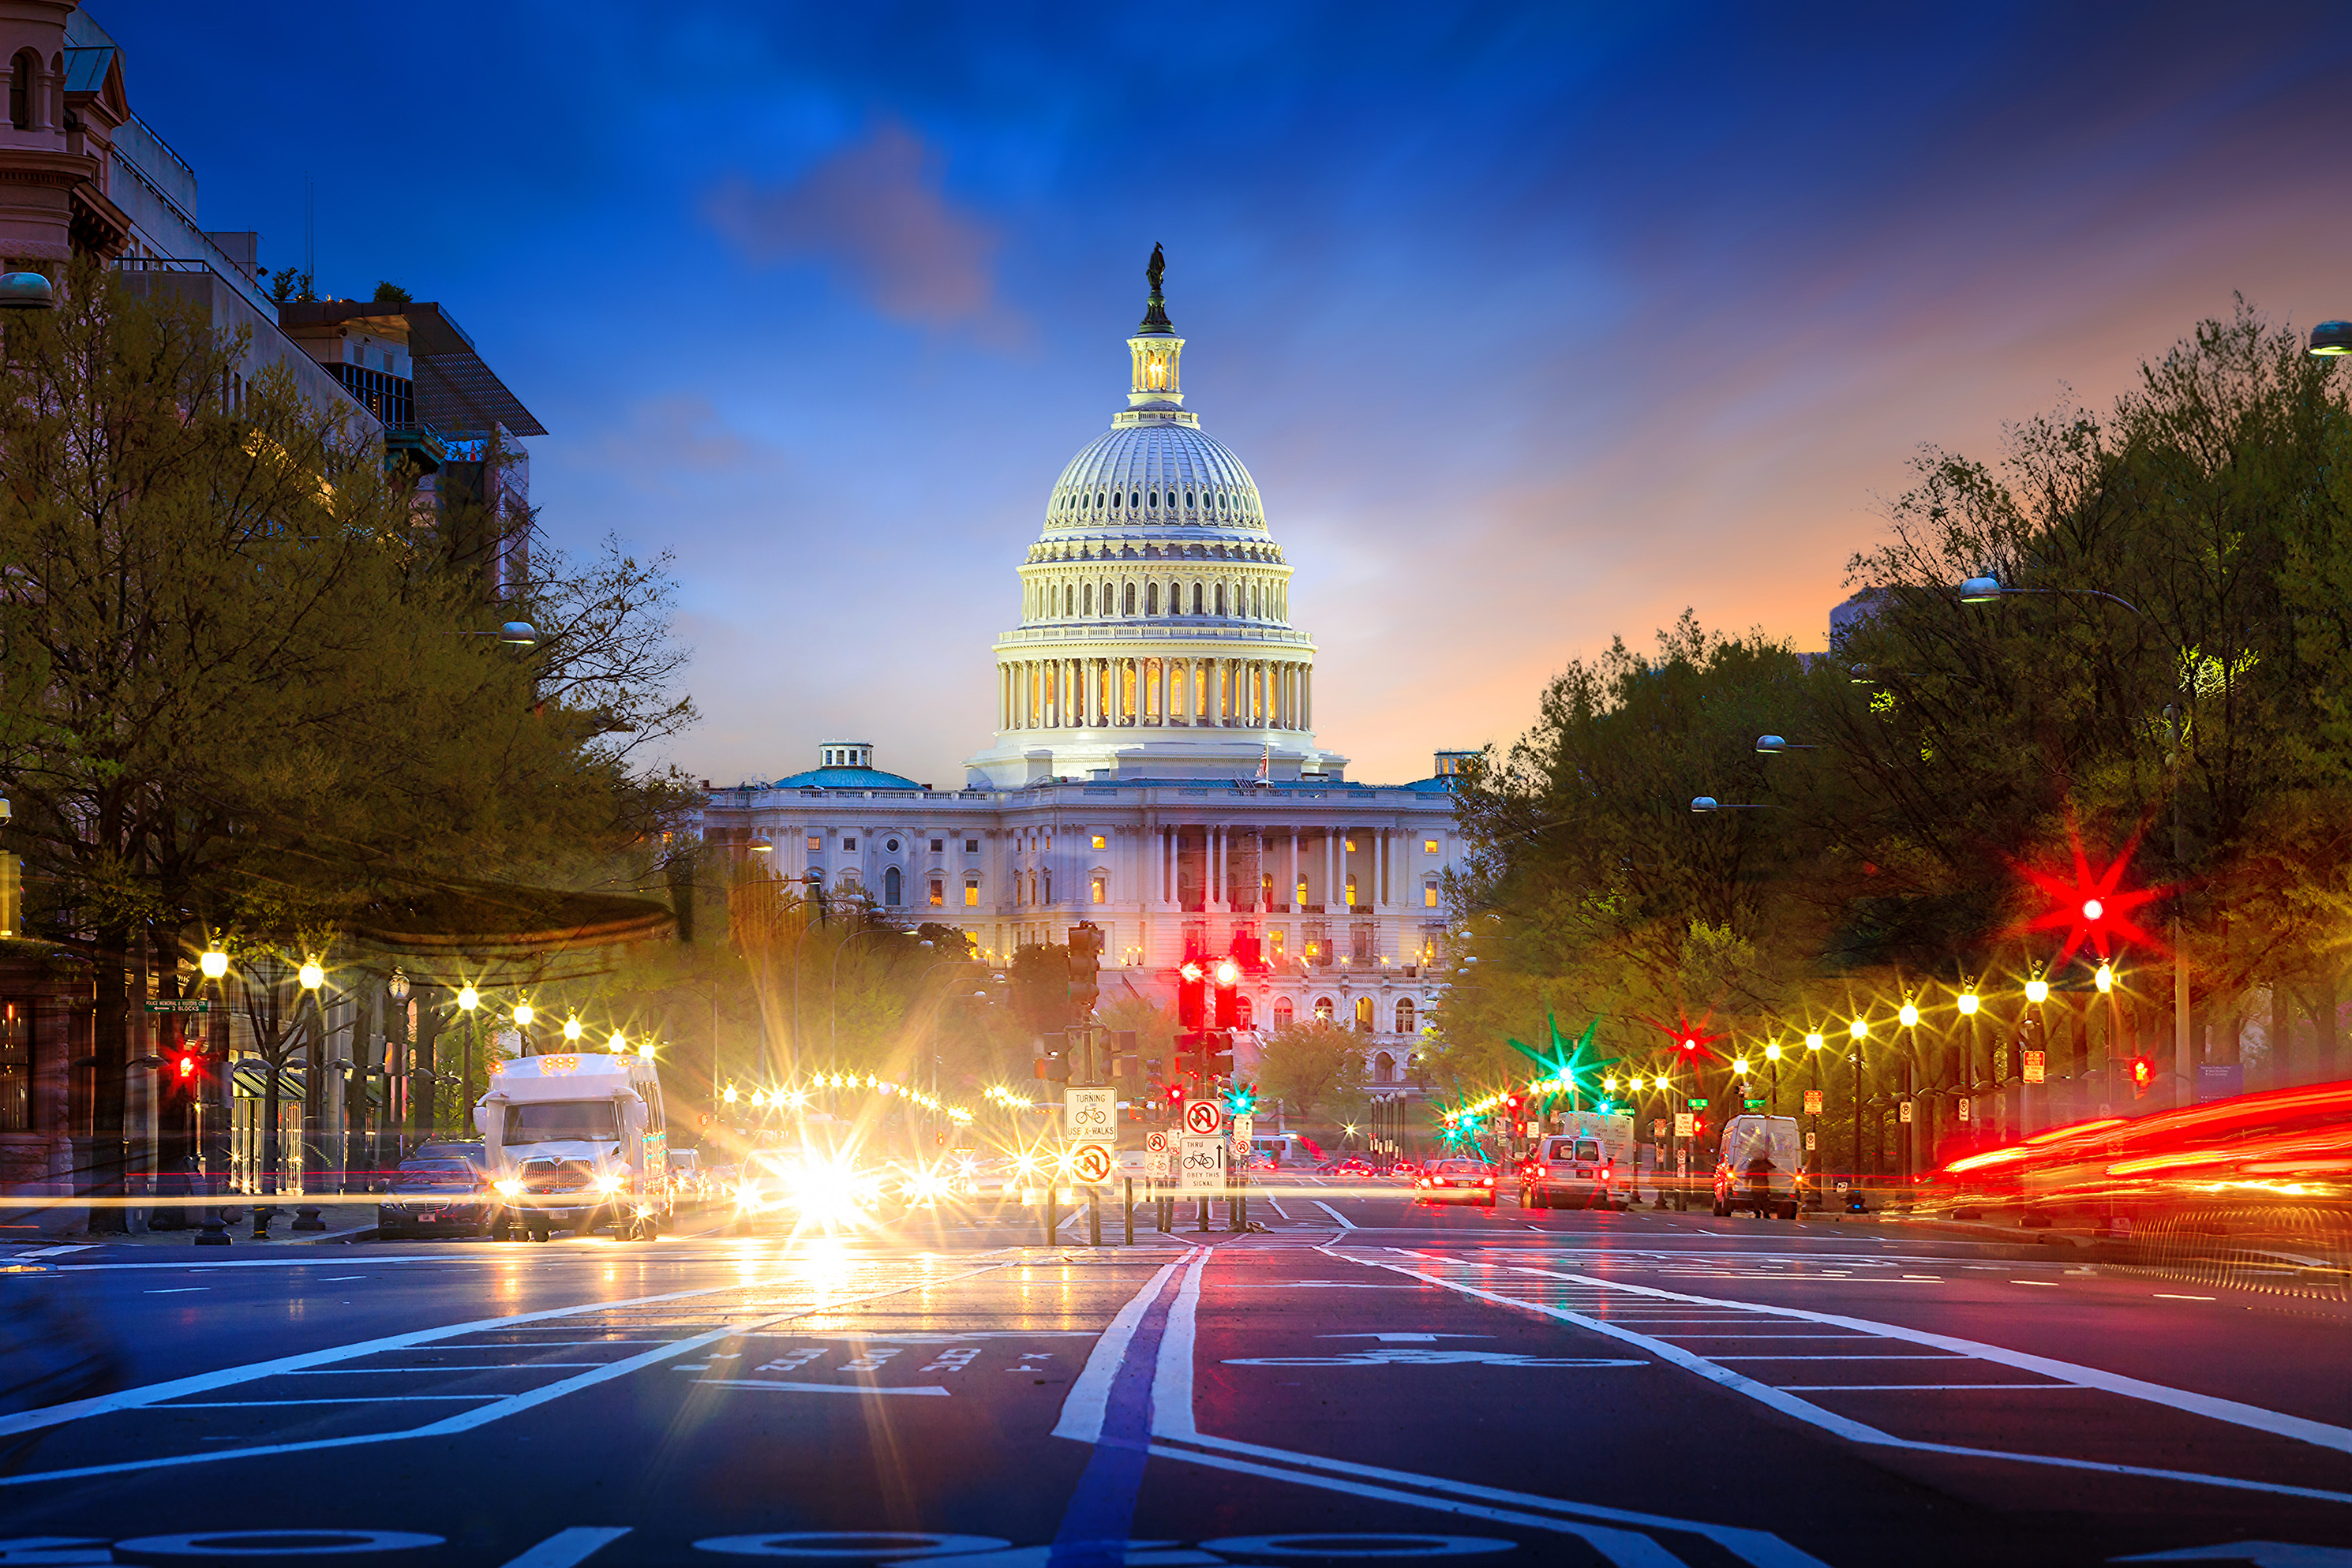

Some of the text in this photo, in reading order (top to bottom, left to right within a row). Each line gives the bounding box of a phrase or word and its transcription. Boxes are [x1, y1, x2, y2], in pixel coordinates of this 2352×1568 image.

[1076, 1094, 1106, 1102] TURNING
[1067, 1127, 1114, 1136] USE X-WALKS
